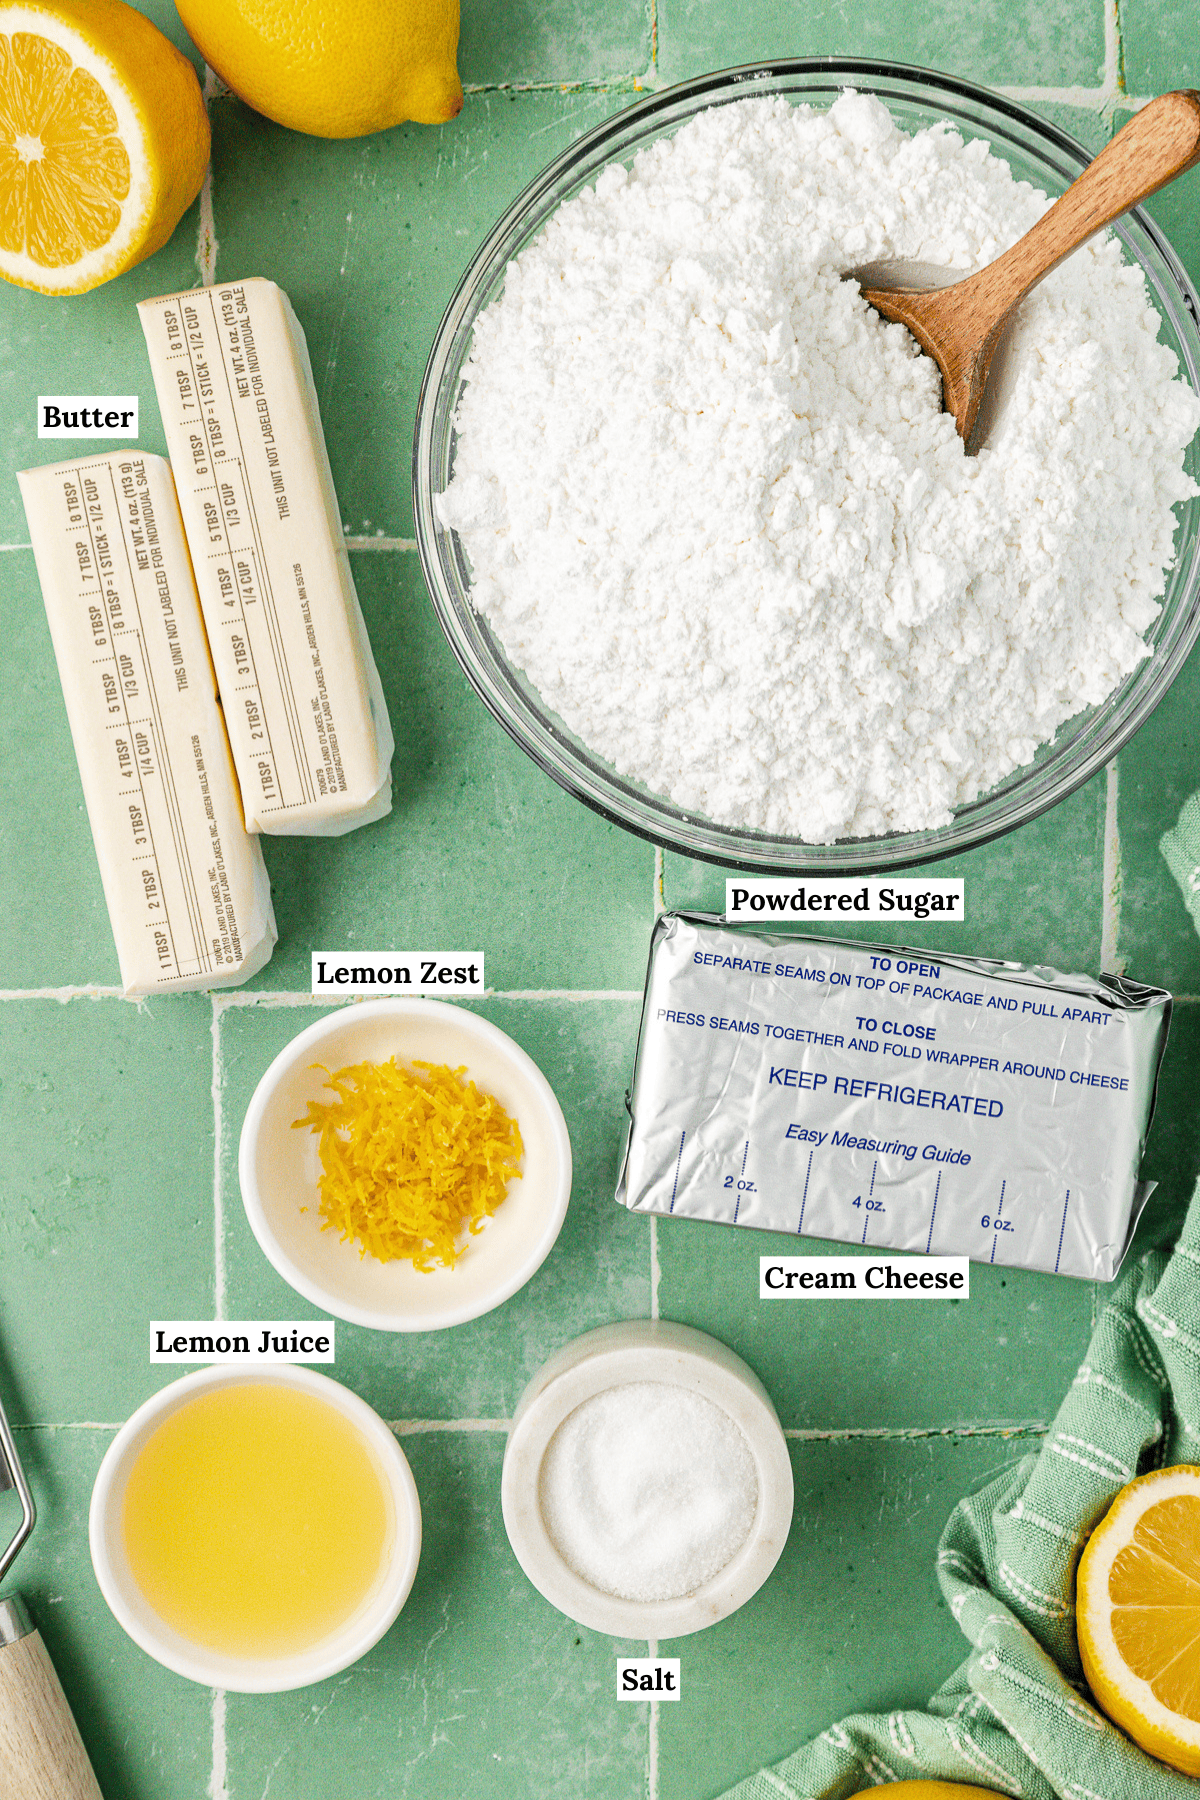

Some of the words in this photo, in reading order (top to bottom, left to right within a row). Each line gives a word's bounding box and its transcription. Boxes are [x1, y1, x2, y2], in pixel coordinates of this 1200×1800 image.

[218, 290, 232, 300] g)
[232, 287, 247, 313] SALE
[164, 310, 179, 340] TBSP
[184, 306, 199, 329] CUP
[221, 303, 237, 325] (113
[189, 332, 203, 350] 1/2
[229, 327, 239, 343] oz.
[239, 315, 260, 372] INDIVIDUAL
[170, 342, 182, 351] 8
[229, 345, 240, 353] 4
[231, 354, 245, 374] WT.
[176, 370, 192, 399] TBSP
[195, 361, 213, 396] STICK
[235, 377, 250, 397] NET
[251, 374, 264, 395] FOR
[255, 398, 274, 443] LABELED
[207, 417, 223, 447] TBSP
[189, 434, 205, 464] TBSP
[214, 449, 225, 458] 8
[265, 446, 279, 467] NOT
[118, 462, 132, 473] g)
[132, 459, 147, 485] SALE
[196, 466, 207, 475] 6
[84, 478, 98, 501] CUP
[121, 476, 136, 497] (113
[270, 470, 284, 493] UNIT
[63, 482, 79, 511] TBSP
[220, 483, 235, 505] CUP
[89, 504, 103, 522] 1/2
[128, 499, 138, 515] oz.
[139, 487, 159, 545] INDIVIDUAL
[203, 502, 219, 532] TBSP
[226, 508, 240, 526] 1/3
[275, 495, 290, 520] THIS
[69, 514, 81, 523] 8
[129, 517, 139, 525] 4
[131, 526, 144, 546] WT.
[210, 534, 221, 542] 5
[75, 541, 91, 571] TBSP
[95, 533, 112, 568] STICK
[135, 549, 149, 570] NET
[150, 547, 163, 568] FOR
[81, 574, 93, 582] 7
[217, 567, 233, 597] TBSP
[237, 561, 251, 584] CUP
[292, 563, 304, 585] 55126
[155, 570, 173, 615] LABELED
[224, 599, 235, 607] 4
[242, 586, 256, 604] 1/4
[298, 587, 307, 599] MN
[106, 589, 122, 619] TBSP
[300, 600, 311, 623] HILLS,
[88, 605, 104, 635] TBSP
[112, 621, 124, 629] 8
[164, 619, 178, 639] NOT
[94, 637, 106, 646] 6
[305, 624, 317, 648] ARDEN
[169, 642, 183, 665] UNIT
[231, 634, 247, 664] TBSP
[119, 654, 134, 677] CUP
[237, 666, 249, 675] 3
[102, 673, 117, 703] TBSP
[124, 680, 138, 697] 1/3
[174, 667, 188, 691] THIS
[108, 705, 120, 713] 5
[244, 699, 260, 729] TBSP
[321, 701, 332, 721] LAND
[251, 731, 263, 740] 2
[326, 722, 335, 732] BY
[115, 738, 131, 768] TBSP
[135, 732, 149, 754] CUP
[191, 734, 202, 757] 55126
[140, 757, 153, 775] 1/4
[195, 758, 204, 771] MN
[321, 745, 331, 765] LAND
[328, 733, 347, 791] MANUFACTURED
[121, 770, 132, 778] 4
[198, 771, 209, 794] HILLS,
[257, 761, 273, 791] TBSP
[315, 768, 327, 795] 700679
[325, 766, 335, 784] 2019
[203, 795, 214, 819] ARDEN
[128, 805, 144, 834] TBSP
[135, 837, 146, 845] 3
[141, 869, 157, 899] TBSP
[218, 871, 229, 891] LAND
[148, 901, 159, 910] 2
[222, 893, 231, 902] BY
[217, 916, 228, 935] LAND
[225, 904, 243, 961] MANUFACTURED
[154, 931, 170, 960] TBSP
[212, 938, 223, 964] 700679
[221, 937, 231, 954] 2019
[870, 956, 891, 971] TO
[896, 960, 940, 978] OPEN
[693, 951, 771, 973] SEPARATE
[774, 964, 825, 982] SEAMS
[829, 972, 851, 986] ON
[855, 975, 885, 990] TOP
[889, 981, 909, 994] OF
[913, 984, 983, 1005] PACKAGE
[986, 996, 1017, 1010] AND
[1022, 1001, 1058, 1017] PULL
[1061, 1007, 1111, 1025] APART
[855, 1016, 877, 1031] TO
[882, 1021, 936, 1040] CLOSE
[657, 1008, 705, 1026] PRESS
[709, 1016, 759, 1034] SEAMS
[764, 1024, 844, 1047] TOGETHER
[847, 1038, 878, 1052] AND
[883, 1042, 921, 1059] FOLD
[926, 1049, 998, 1071] WRAPPER
[1002, 1061, 1065, 1080] AROUND
[1069, 1071, 1128, 1090] CHEESE
[769, 1066, 827, 1090] KEEP
[833, 1076, 1003, 1117] REFRIGERATED
[785, 1123, 828, 1146] Easy
[831, 1131, 917, 1160] Measuring
[922, 1145, 971, 1165] Guide
[723, 1176, 733, 1187] 2
[737, 1180, 756, 1191] oz.
[852, 1196, 861, 1208] 4
[865, 1200, 885, 1211] oz.
[981, 1215, 990, 1227] 6
[993, 1220, 1014, 1231] oz.
